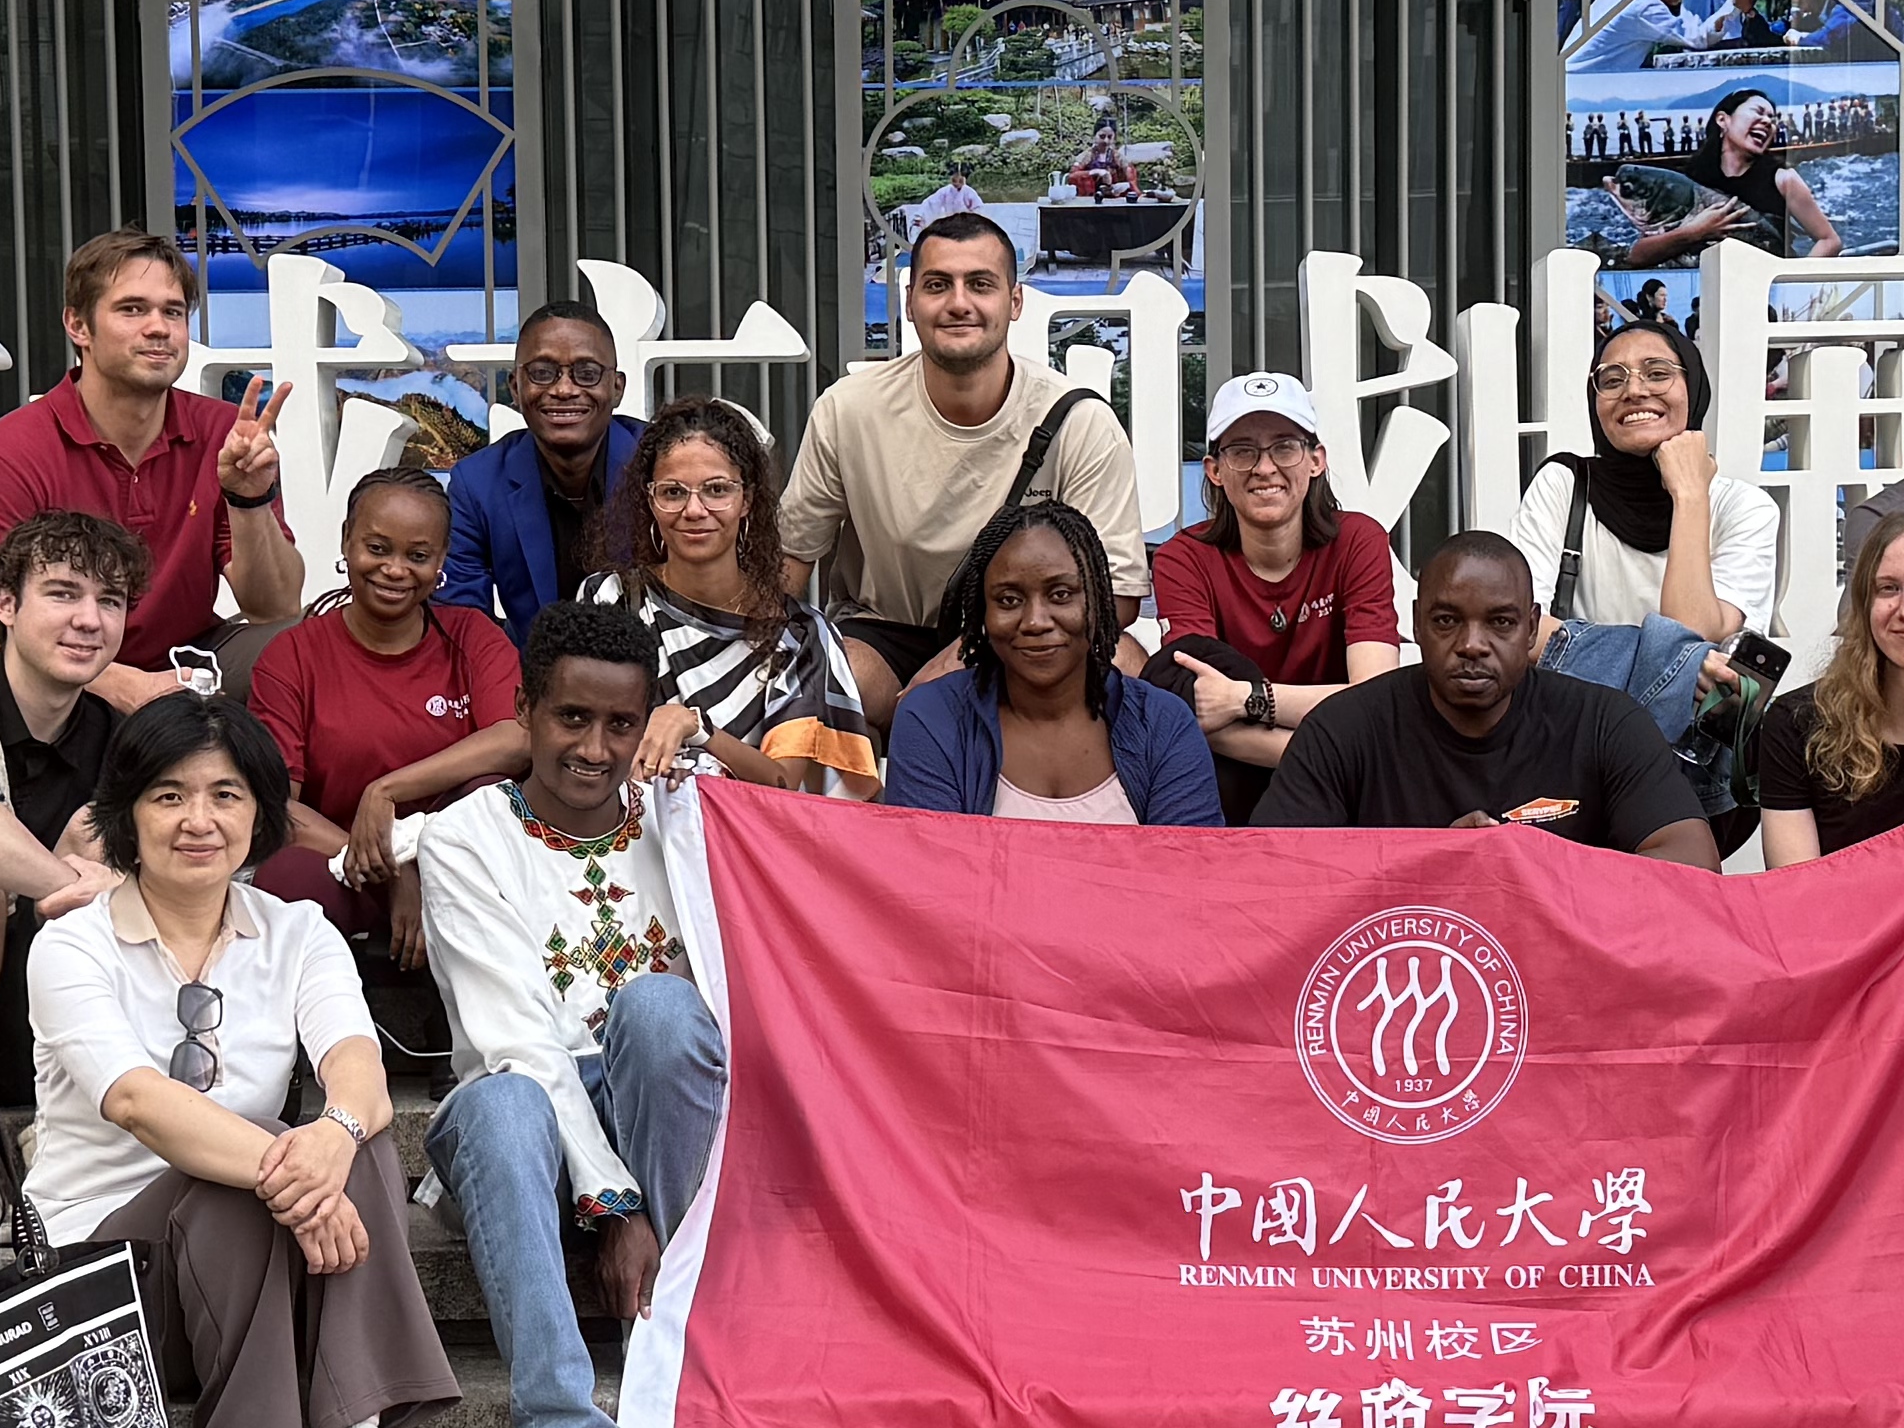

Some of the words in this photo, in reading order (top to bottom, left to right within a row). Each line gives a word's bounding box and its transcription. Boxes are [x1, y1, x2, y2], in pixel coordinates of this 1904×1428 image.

[1308, 965, 1341, 1056] RENMIN
[1337, 918, 1474, 965] UNIVERSITY
[1474, 946, 1502, 973] OF
[1494, 979, 1518, 1056] CHINA
[1395, 1078, 1433, 1092] 1937
[1179, 1264, 1297, 1287] RENMIN
[1312, 1266, 1491, 1290] UNIVERSITY
[1504, 1265, 1545, 1289] OF
[1559, 1263, 1656, 1288] CHINA
[1299, 1315, 1544, 1361] 苏州校区
